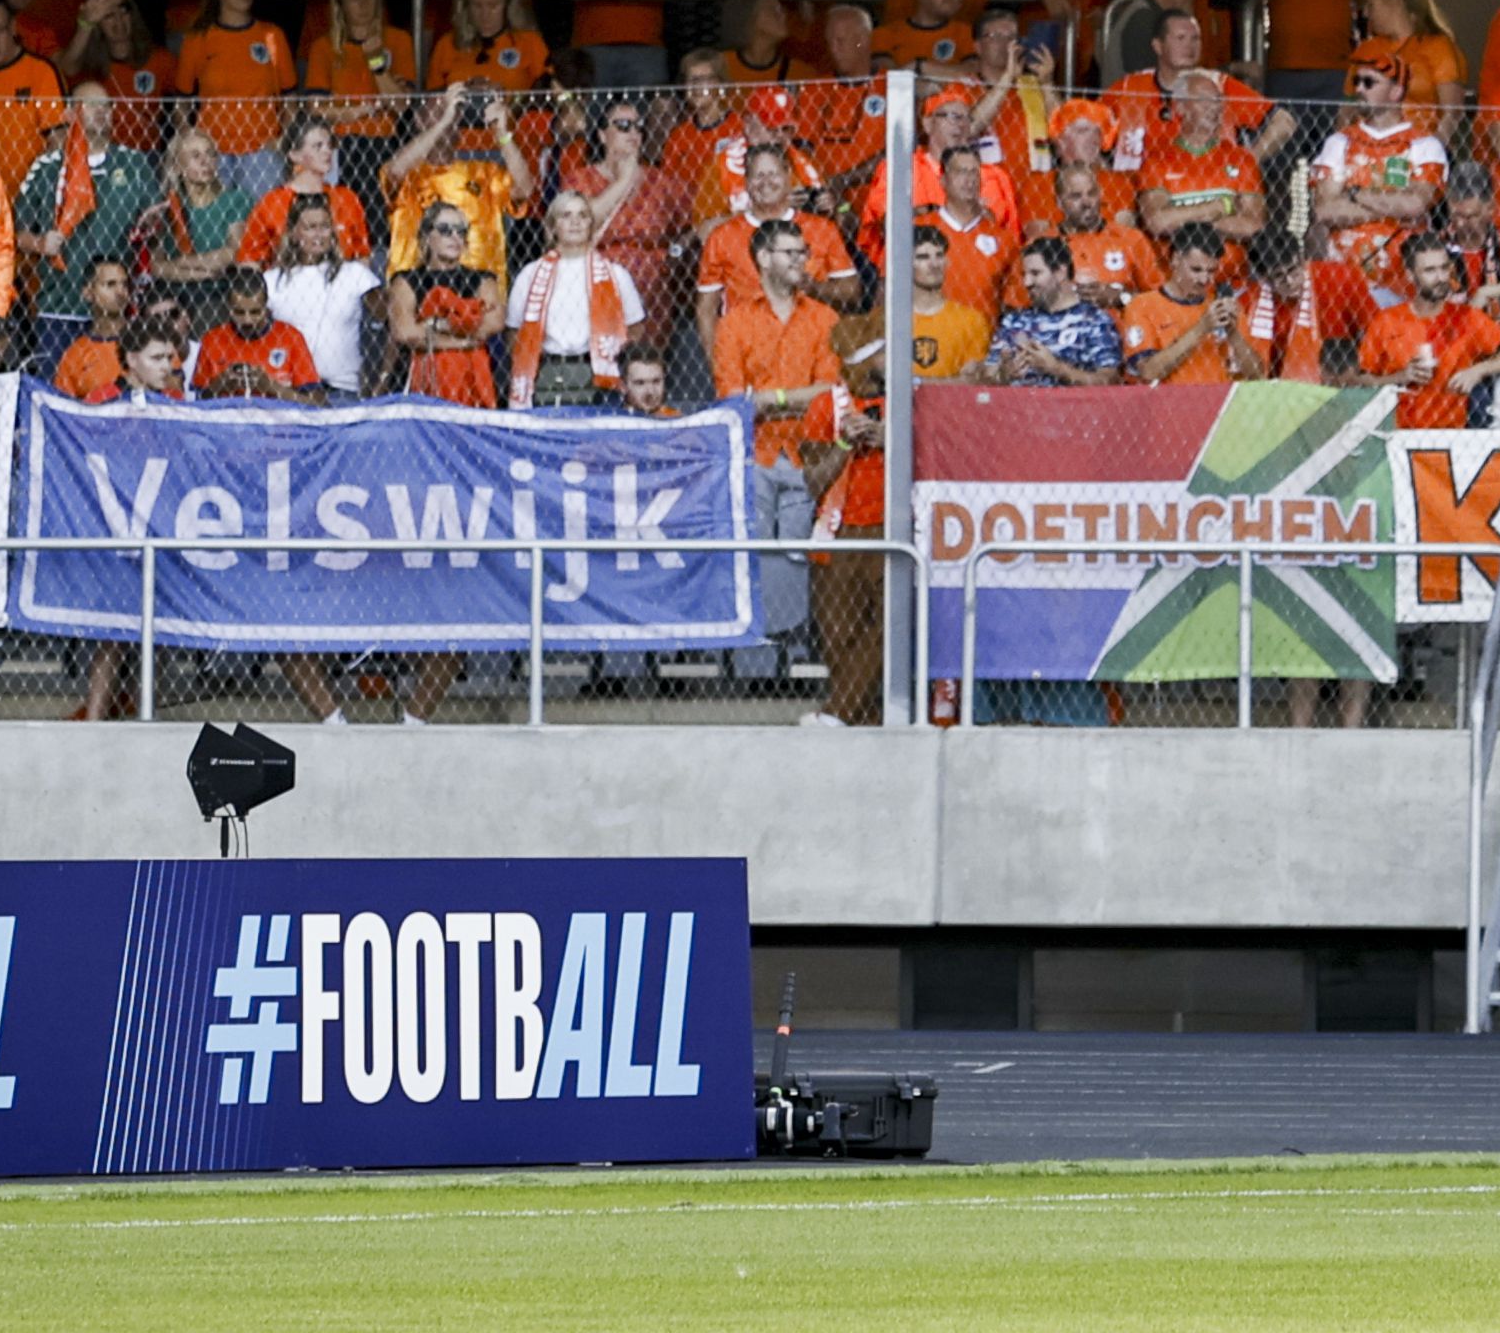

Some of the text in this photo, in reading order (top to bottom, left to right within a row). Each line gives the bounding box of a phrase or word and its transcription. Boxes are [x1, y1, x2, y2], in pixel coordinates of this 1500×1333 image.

[84, 456, 687, 603] Velswijk
[930, 496, 1379, 566] DOETINCHEM
[204, 910, 701, 1107] #FOOTBALL
